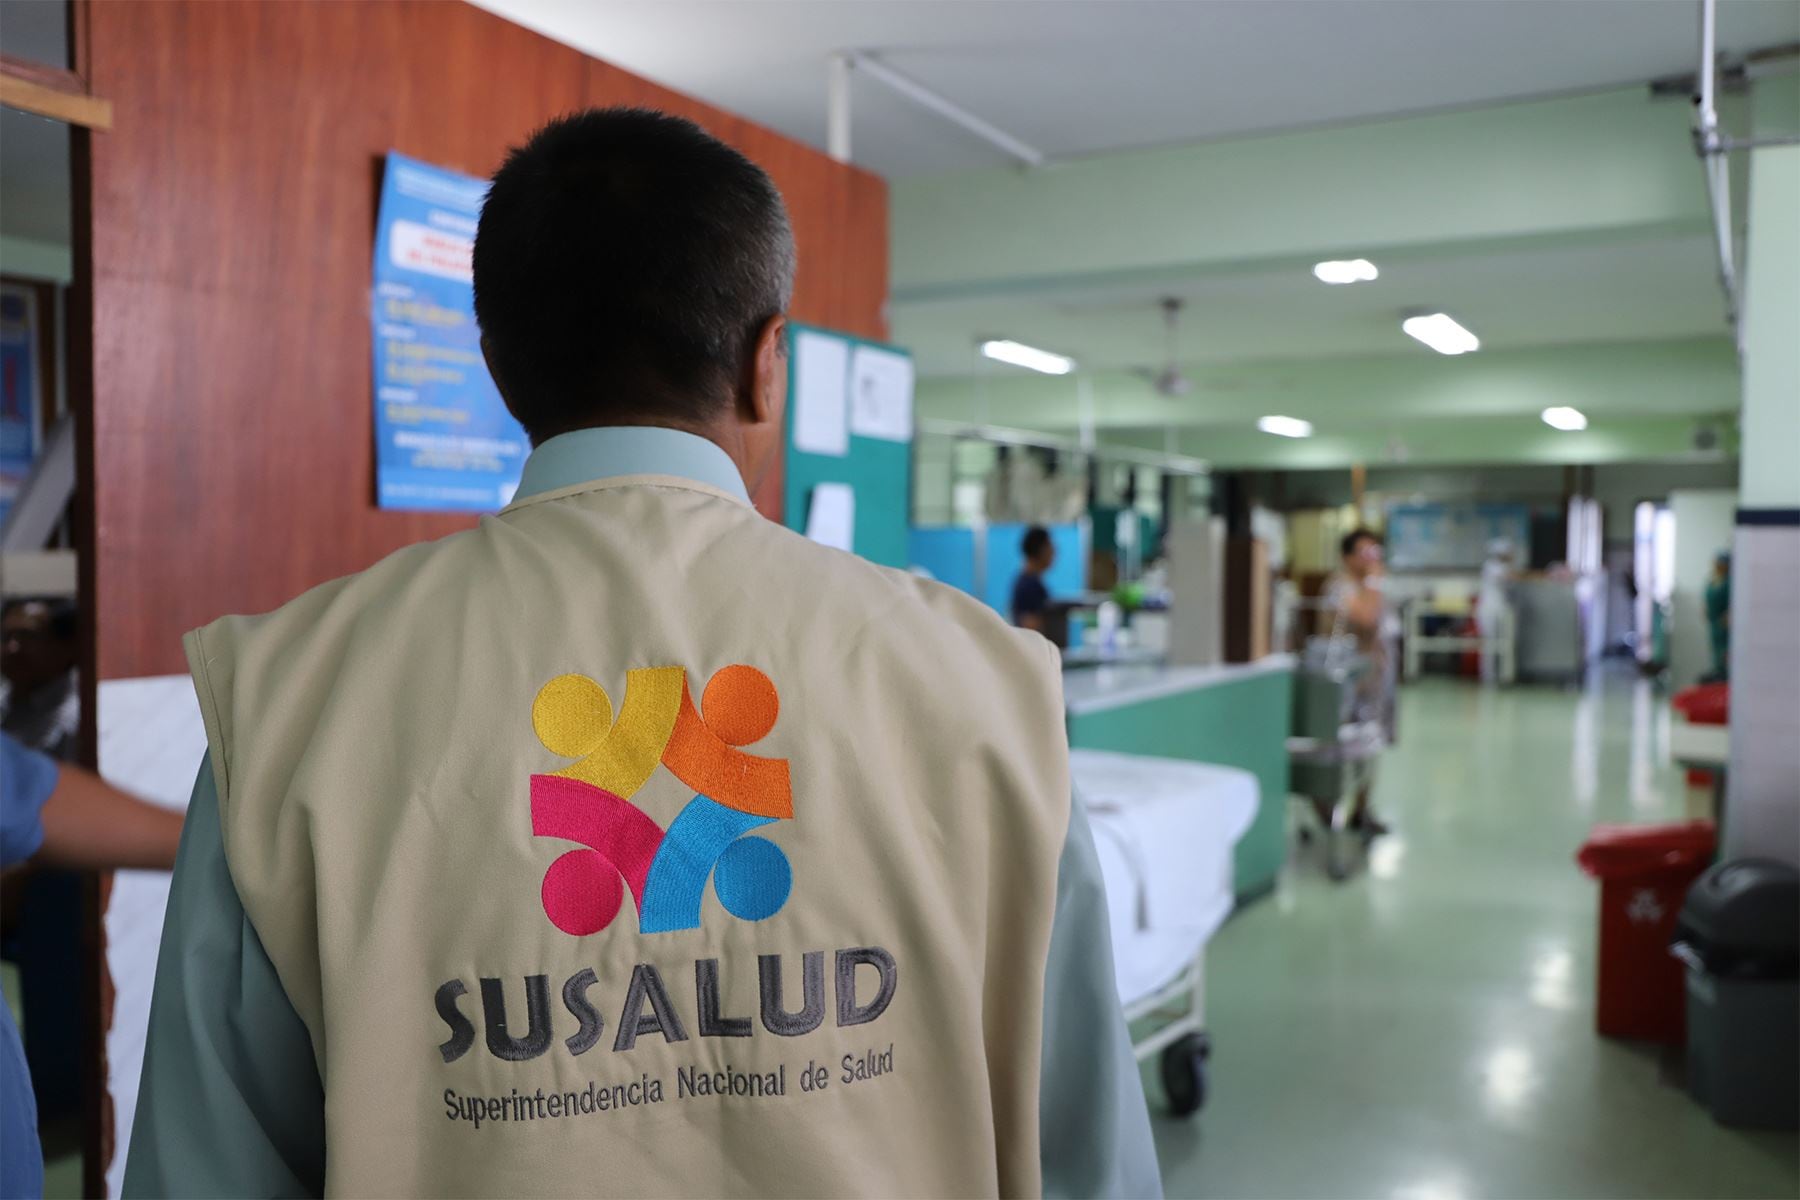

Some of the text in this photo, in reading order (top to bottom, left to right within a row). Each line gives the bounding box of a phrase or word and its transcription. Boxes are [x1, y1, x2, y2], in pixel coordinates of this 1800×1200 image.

[434, 946, 898, 1063] SUSALUD
[445, 1043, 894, 1129] Superintendencia Nacional de Salud
